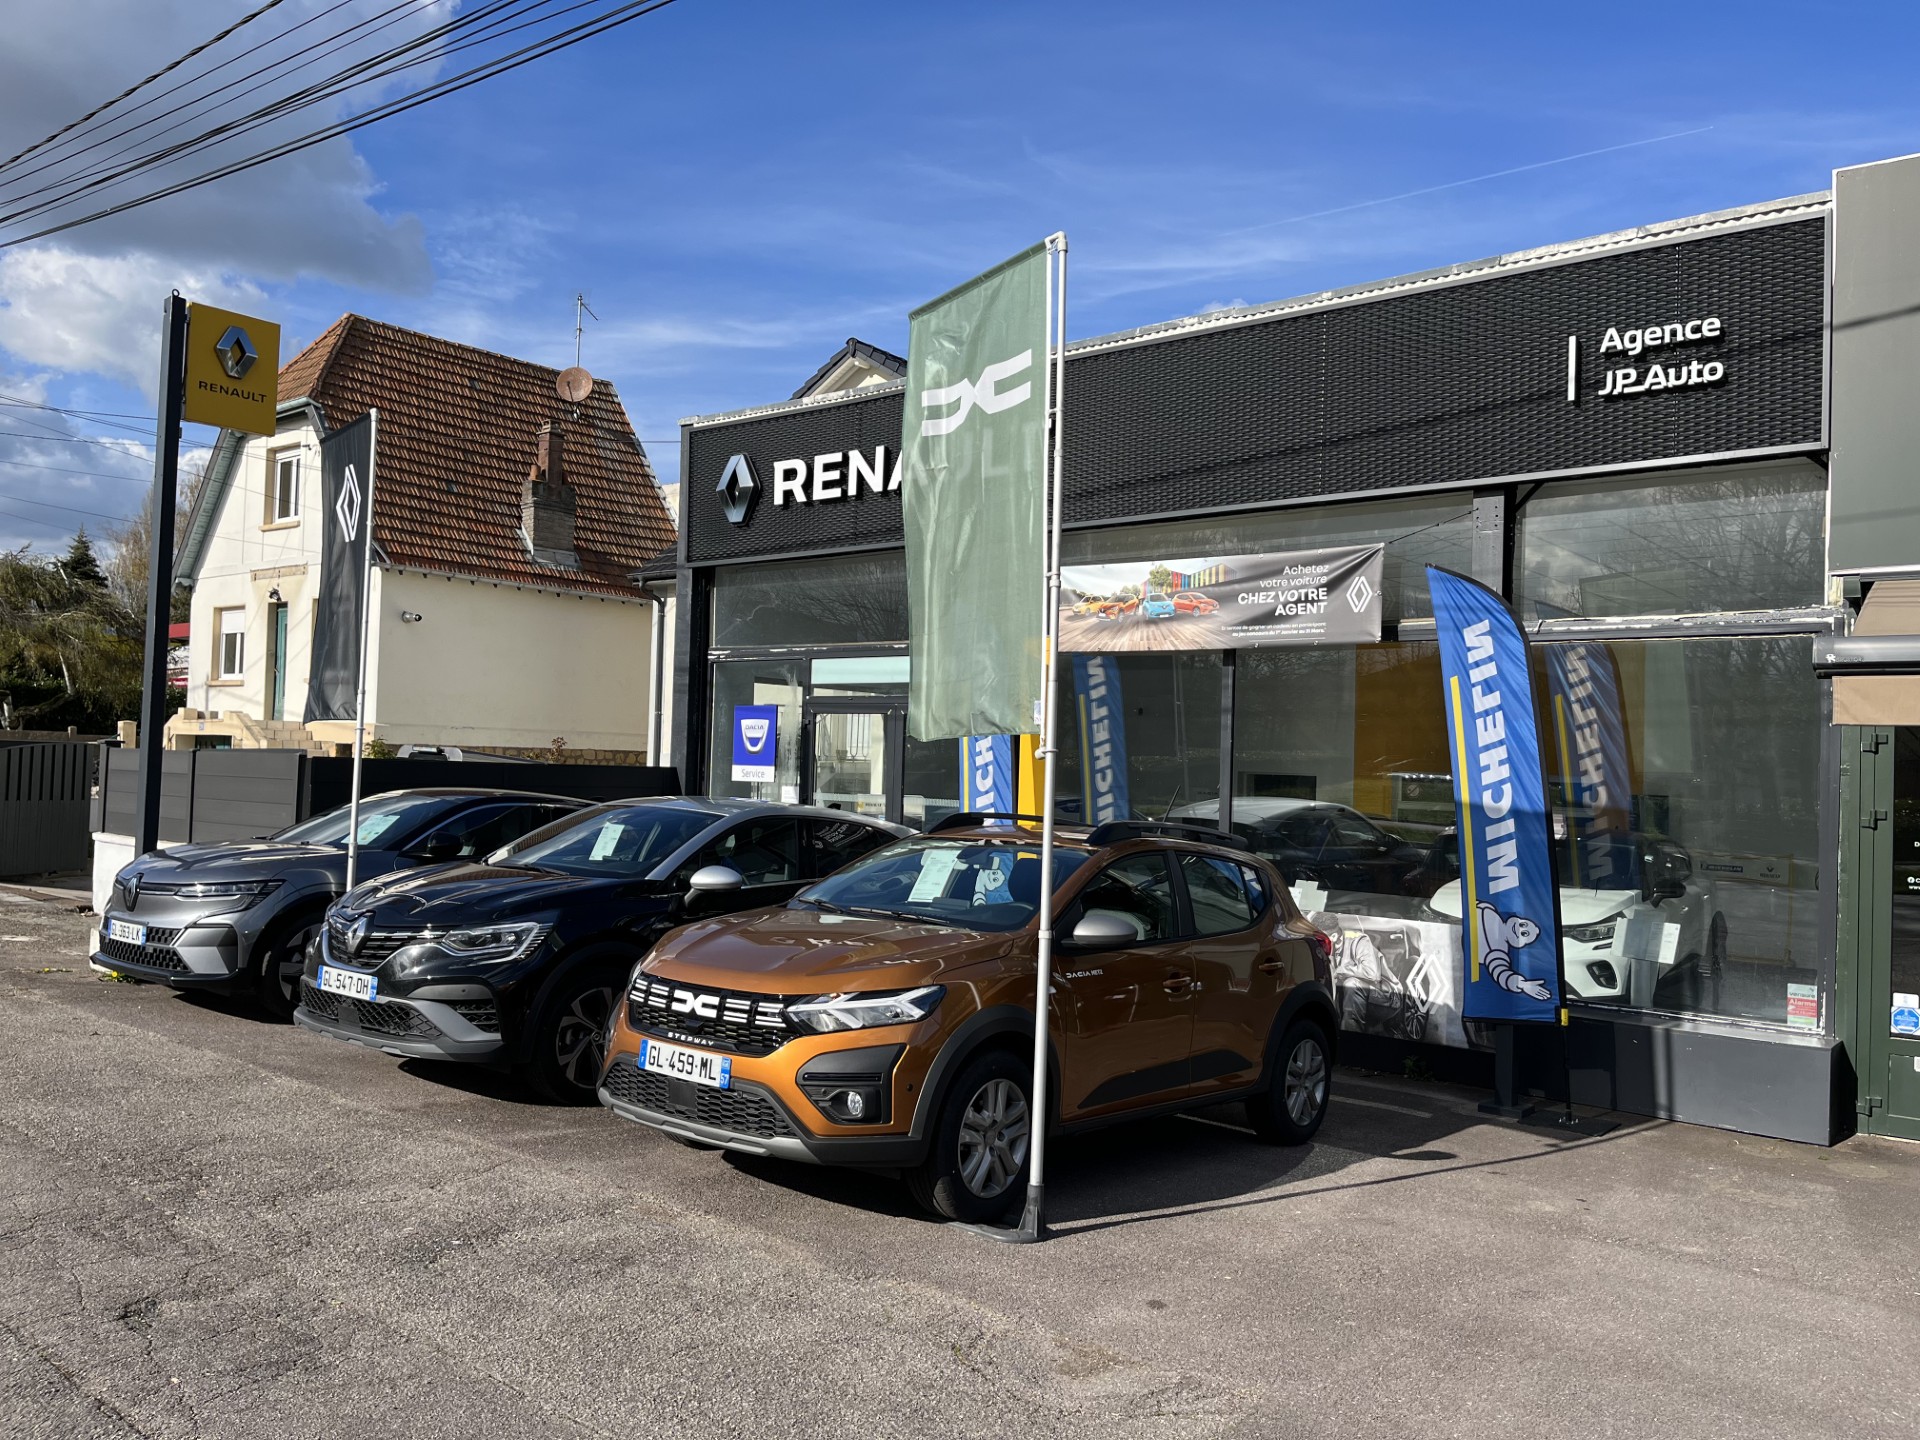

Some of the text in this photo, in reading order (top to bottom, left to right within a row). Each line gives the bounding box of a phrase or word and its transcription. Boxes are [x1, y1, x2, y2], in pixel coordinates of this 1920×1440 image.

[1600, 317, 1721, 355] Agence
[1598, 360, 1724, 395] JP Auto
[198, 380, 267, 403] RENAULT
[1283, 564, 1329, 576] Achetez
[1260, 575, 1328, 588] votre voiture
[1237, 587, 1328, 605] CHEZ VOTRE
[1274, 602, 1328, 616] AGENT
[741, 768, 766, 778] Service
[1065, 970, 1091, 979] DACIA
[323, 970, 369, 995] GL-547-DH
[1788, 998, 1817, 1007] Alarme
[668, 1031, 714, 1046] STEPWAY
[648, 1045, 717, 1081] GL-459-ML
[720, 1072, 730, 1085] 57
